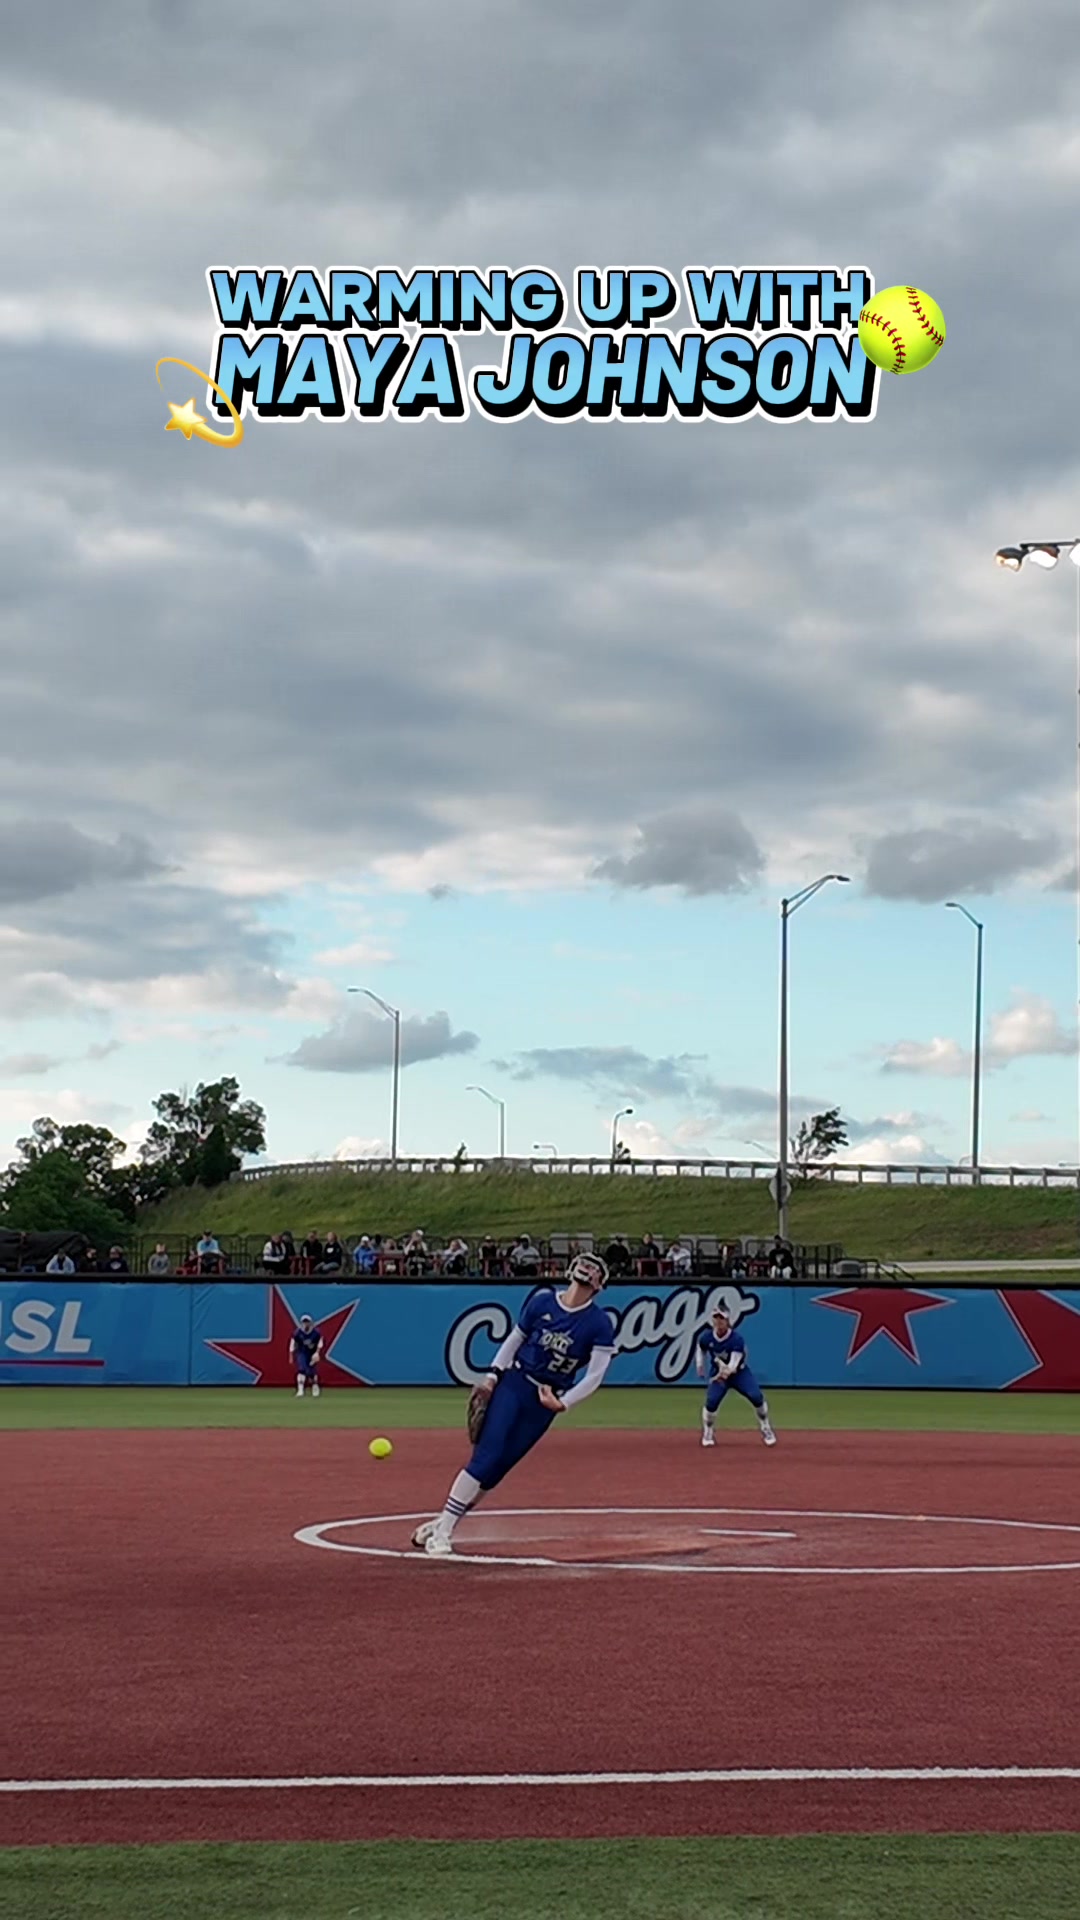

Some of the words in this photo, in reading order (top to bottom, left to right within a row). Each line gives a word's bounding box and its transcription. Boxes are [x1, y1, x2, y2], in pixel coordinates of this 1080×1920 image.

[0, 1299, 92, 1353] SL
[448, 1285, 758, 1388] Cago
[547, 1351, 579, 1374] 23
